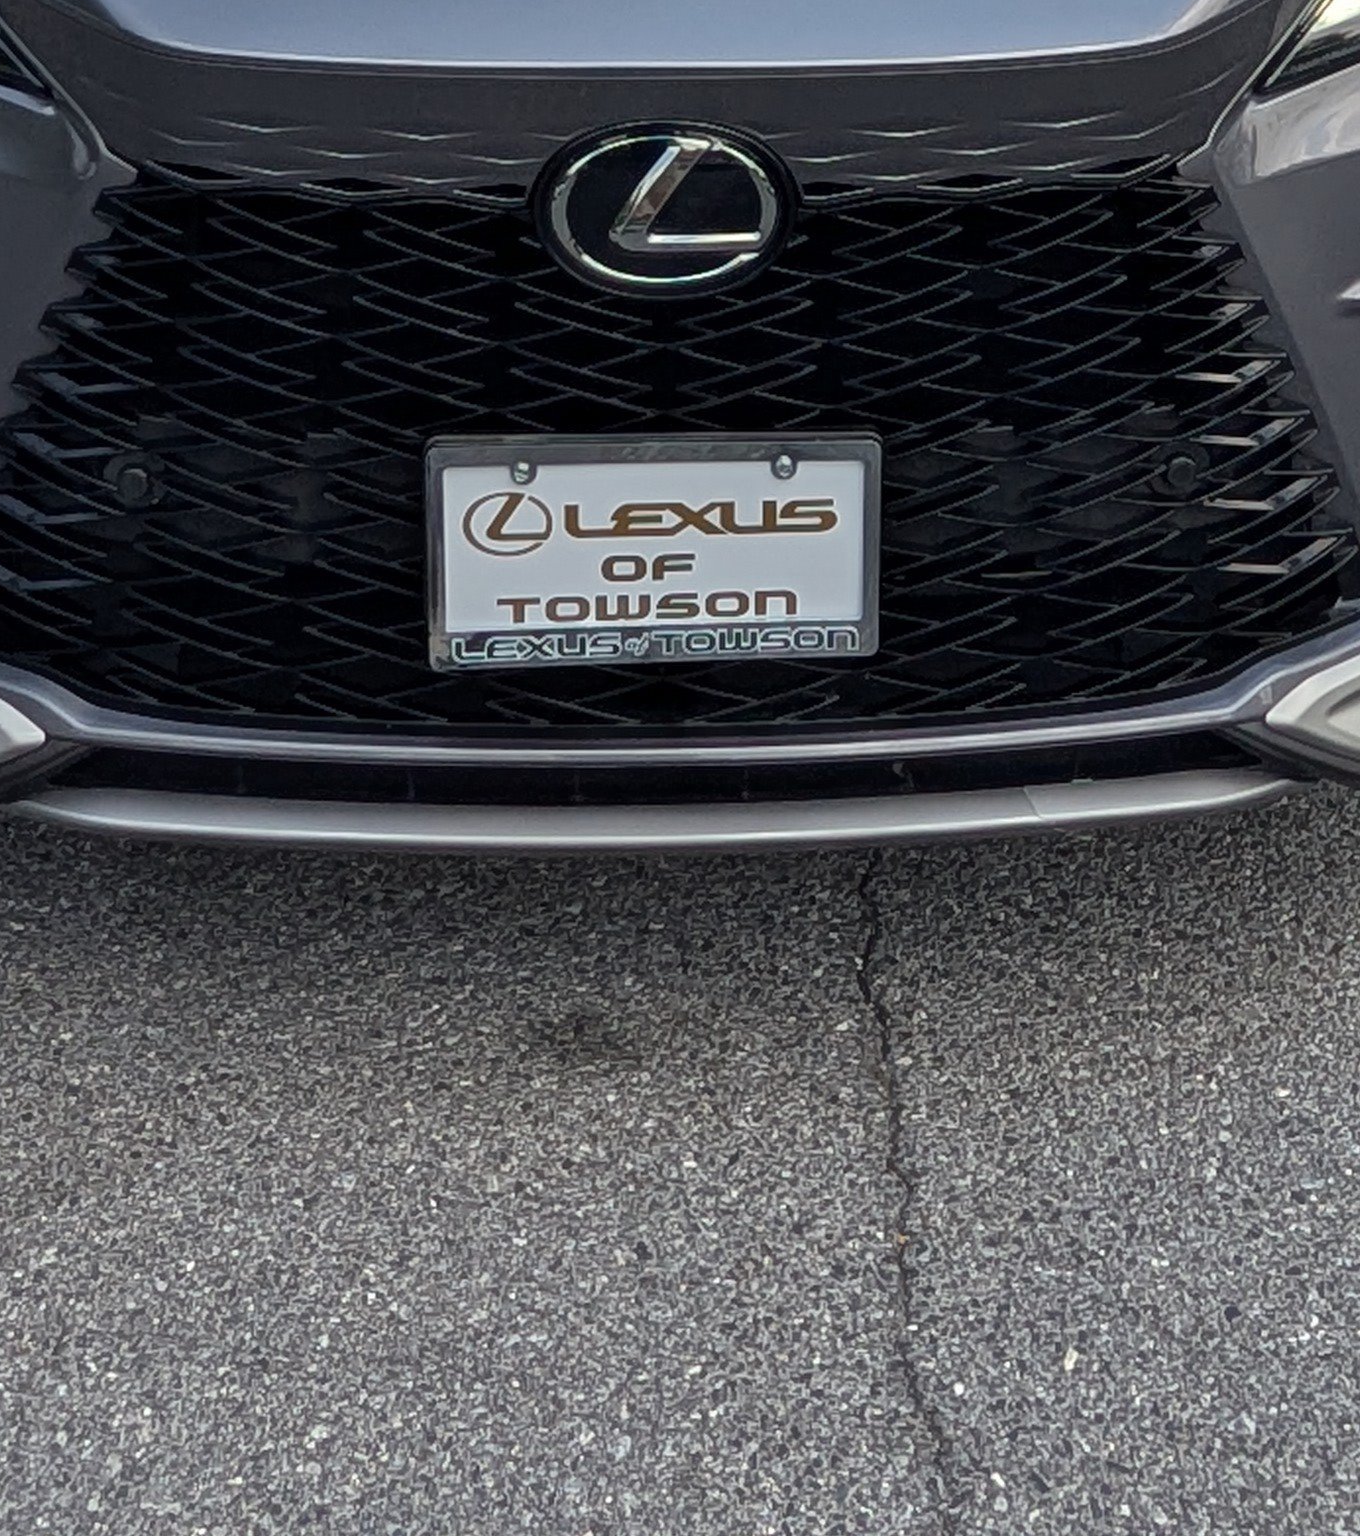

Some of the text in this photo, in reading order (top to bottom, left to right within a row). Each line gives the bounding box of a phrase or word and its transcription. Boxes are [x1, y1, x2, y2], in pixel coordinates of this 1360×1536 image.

[562, 498, 839, 538] LEXUS
[600, 552, 697, 583] OF
[496, 589, 799, 625] TOWSON
[452, 632, 622, 663] LEXUS
[653, 624, 861, 655] TOWSON
